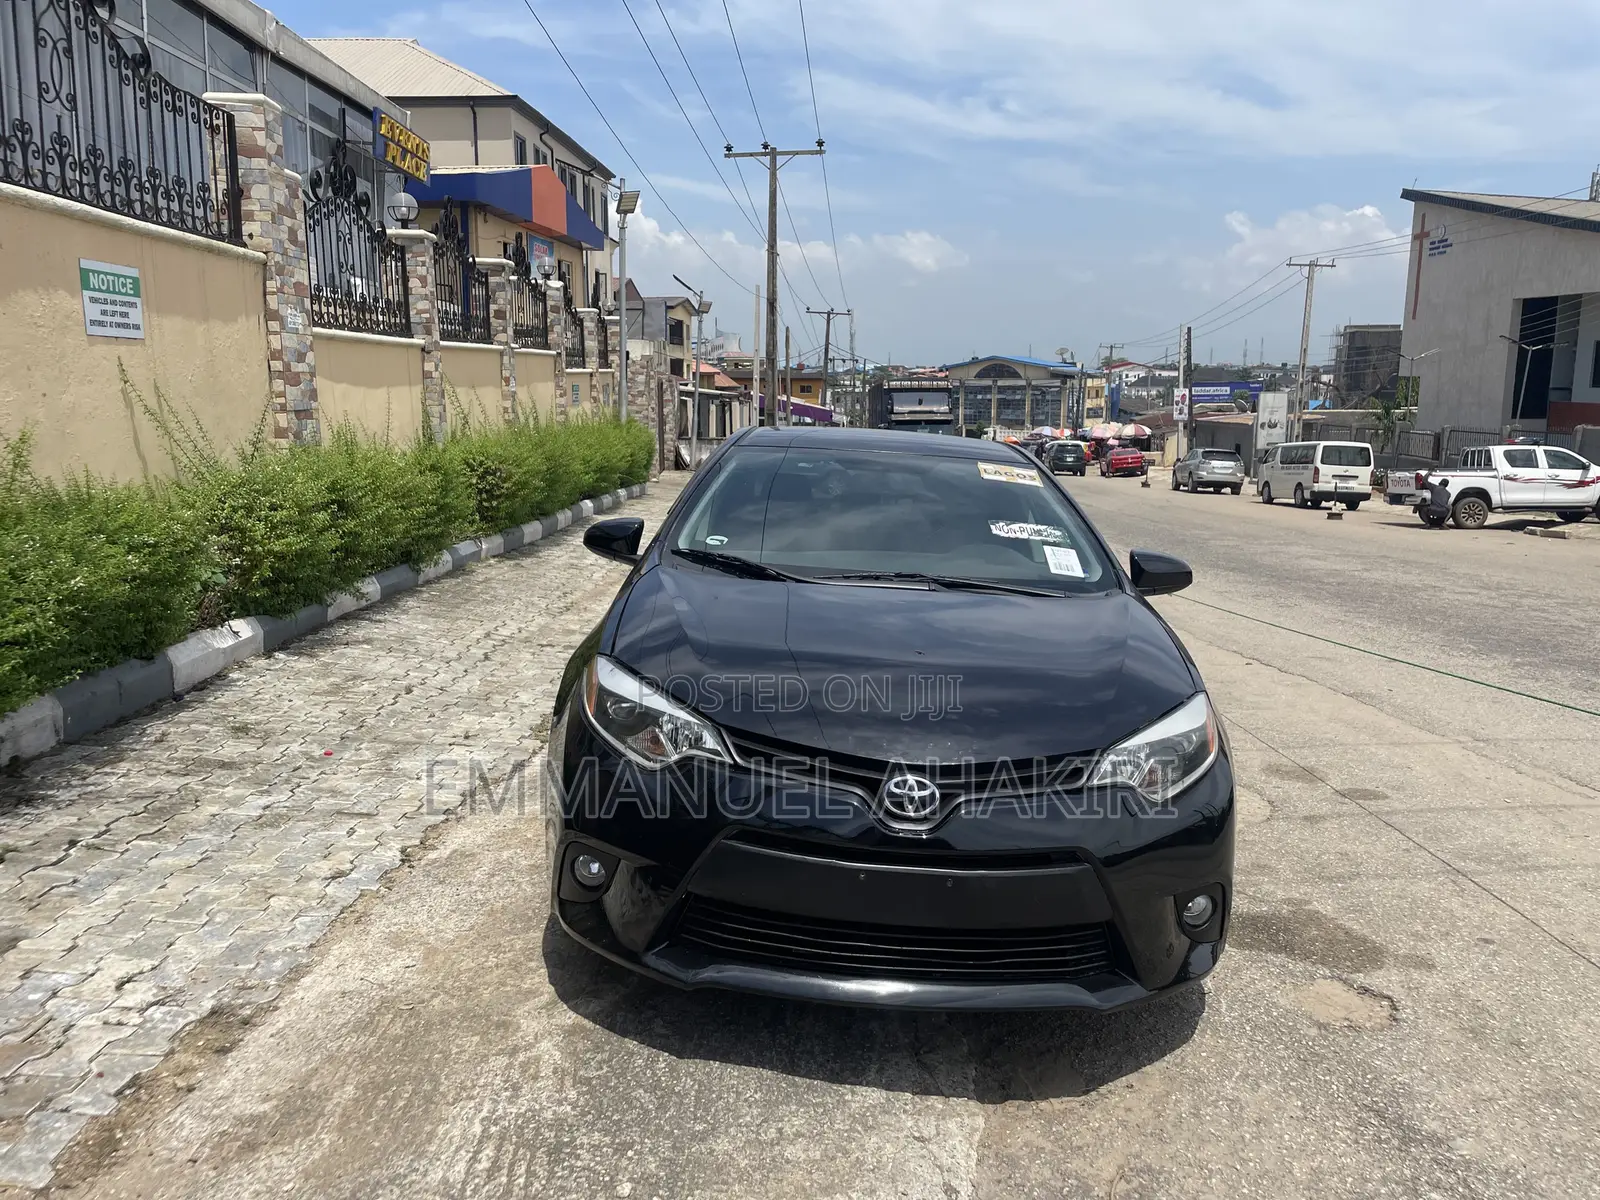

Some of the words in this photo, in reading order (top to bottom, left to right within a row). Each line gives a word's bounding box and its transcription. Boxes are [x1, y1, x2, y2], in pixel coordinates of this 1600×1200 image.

[380, 114, 430, 161] EVENTS
[384, 140, 428, 182] PLACE
[89, 272, 134, 294] NOTICE
[88, 296, 109, 306] VEHICLES
[109, 298, 118, 307] AND
[118, 300, 138, 309] CONTENTS
[100, 309, 109, 317] ARE
[109, 310, 119, 318] LEFT
[119, 311, 130, 319] HERE
[89, 319, 108, 328] ENTIRELY
[109, 321, 114, 329] AT
[115, 322, 132, 330] OWNERS
[1391, 479, 1411, 488] TOYOTA
